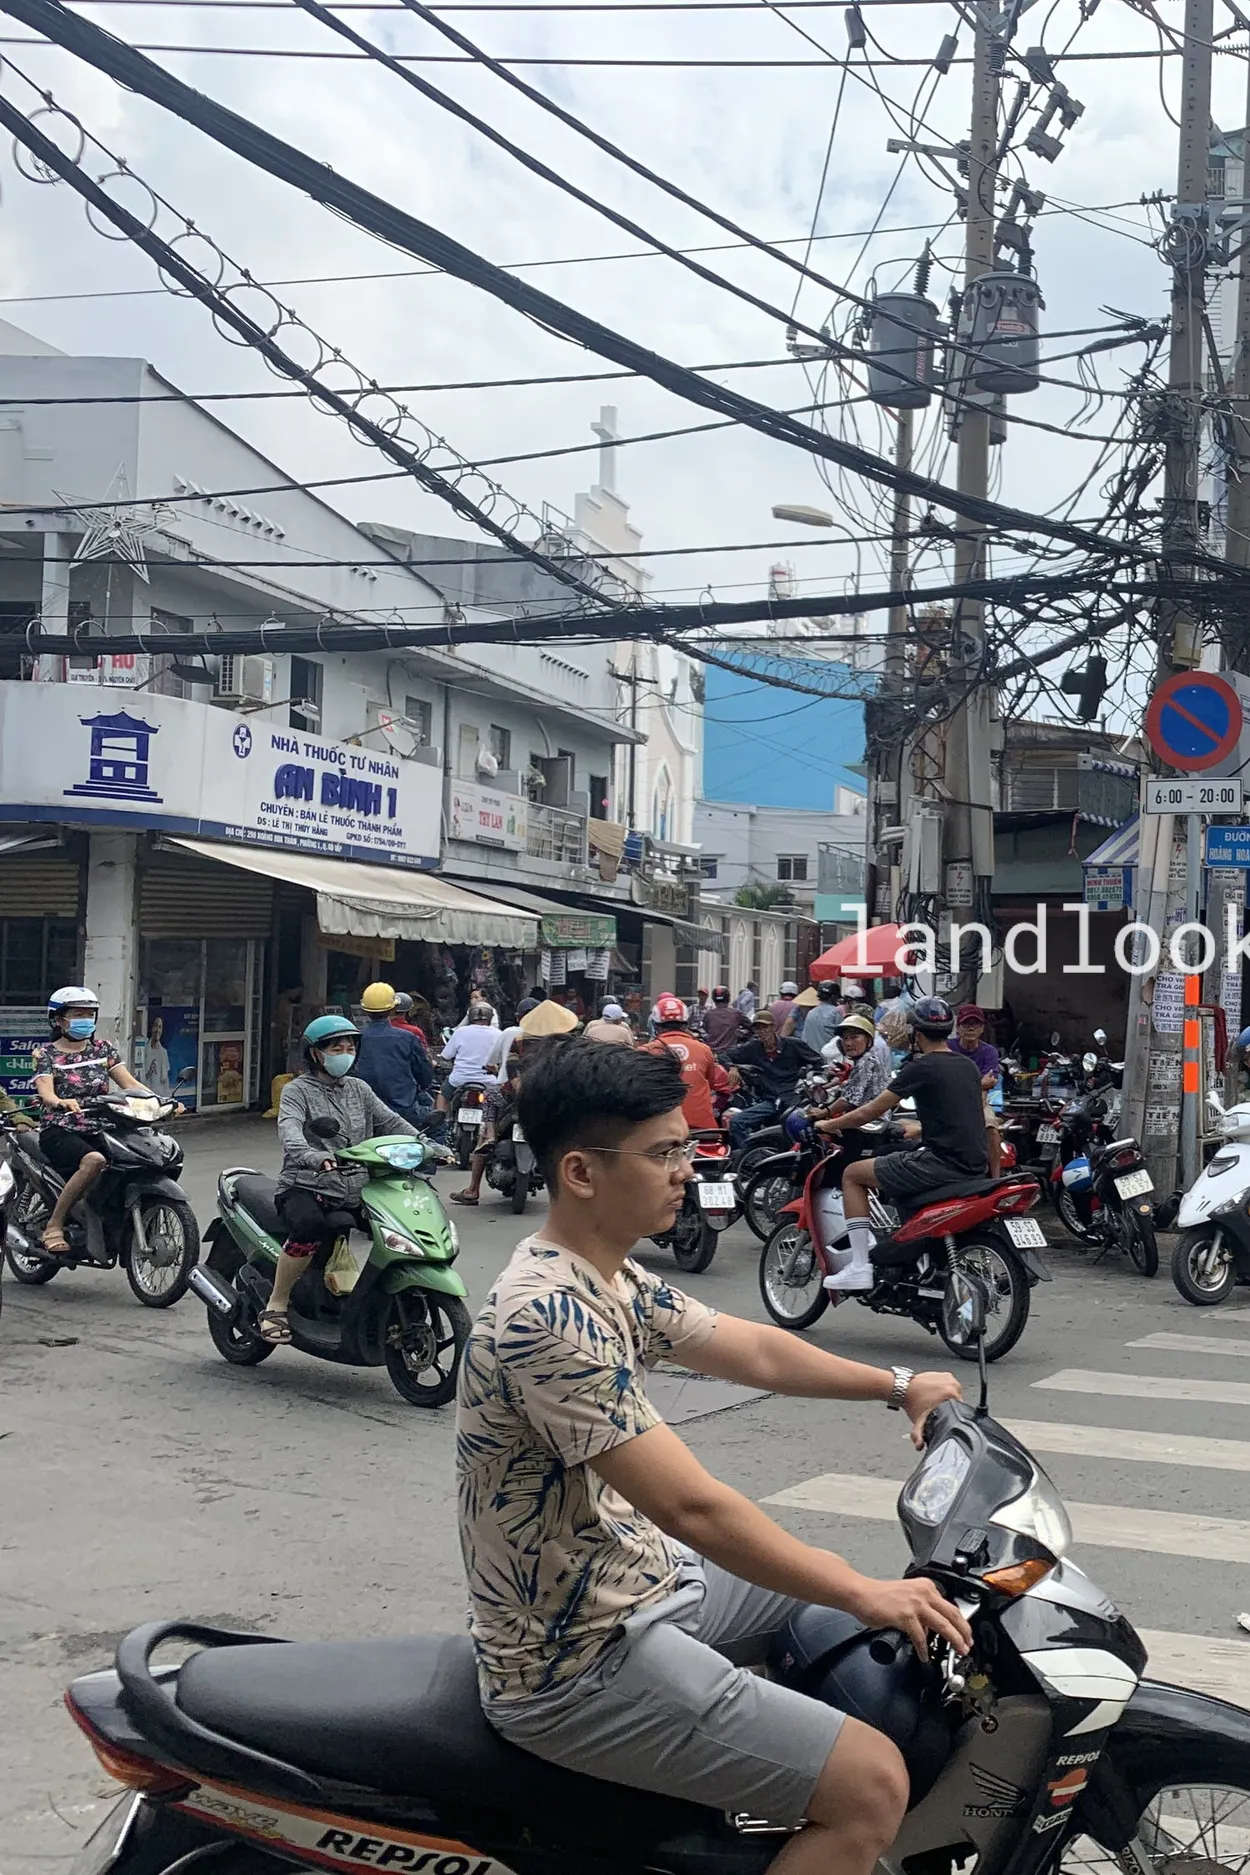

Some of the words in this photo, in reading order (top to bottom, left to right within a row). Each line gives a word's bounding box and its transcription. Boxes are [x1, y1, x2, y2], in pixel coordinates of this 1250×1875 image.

[271, 734, 299, 755] NHÀ
[303, 743, 346, 766] THUỐC
[350, 754, 366, 770] TƯ
[368, 760, 399, 779] NHÂN
[274, 763, 315, 801] AN
[321, 768, 382, 816] BÌNH
[1155, 789, 1182, 804] 6:00
[1200, 788, 1234, 803] 20:00
[260, 801, 294, 818] CHUYÊN
[300, 809, 317, 822] BÁN
[330, 813, 356, 828] THUỐC
[1209, 844, 1232, 861] HOÀNG
[1236, 848, 1250, 862] HOA
